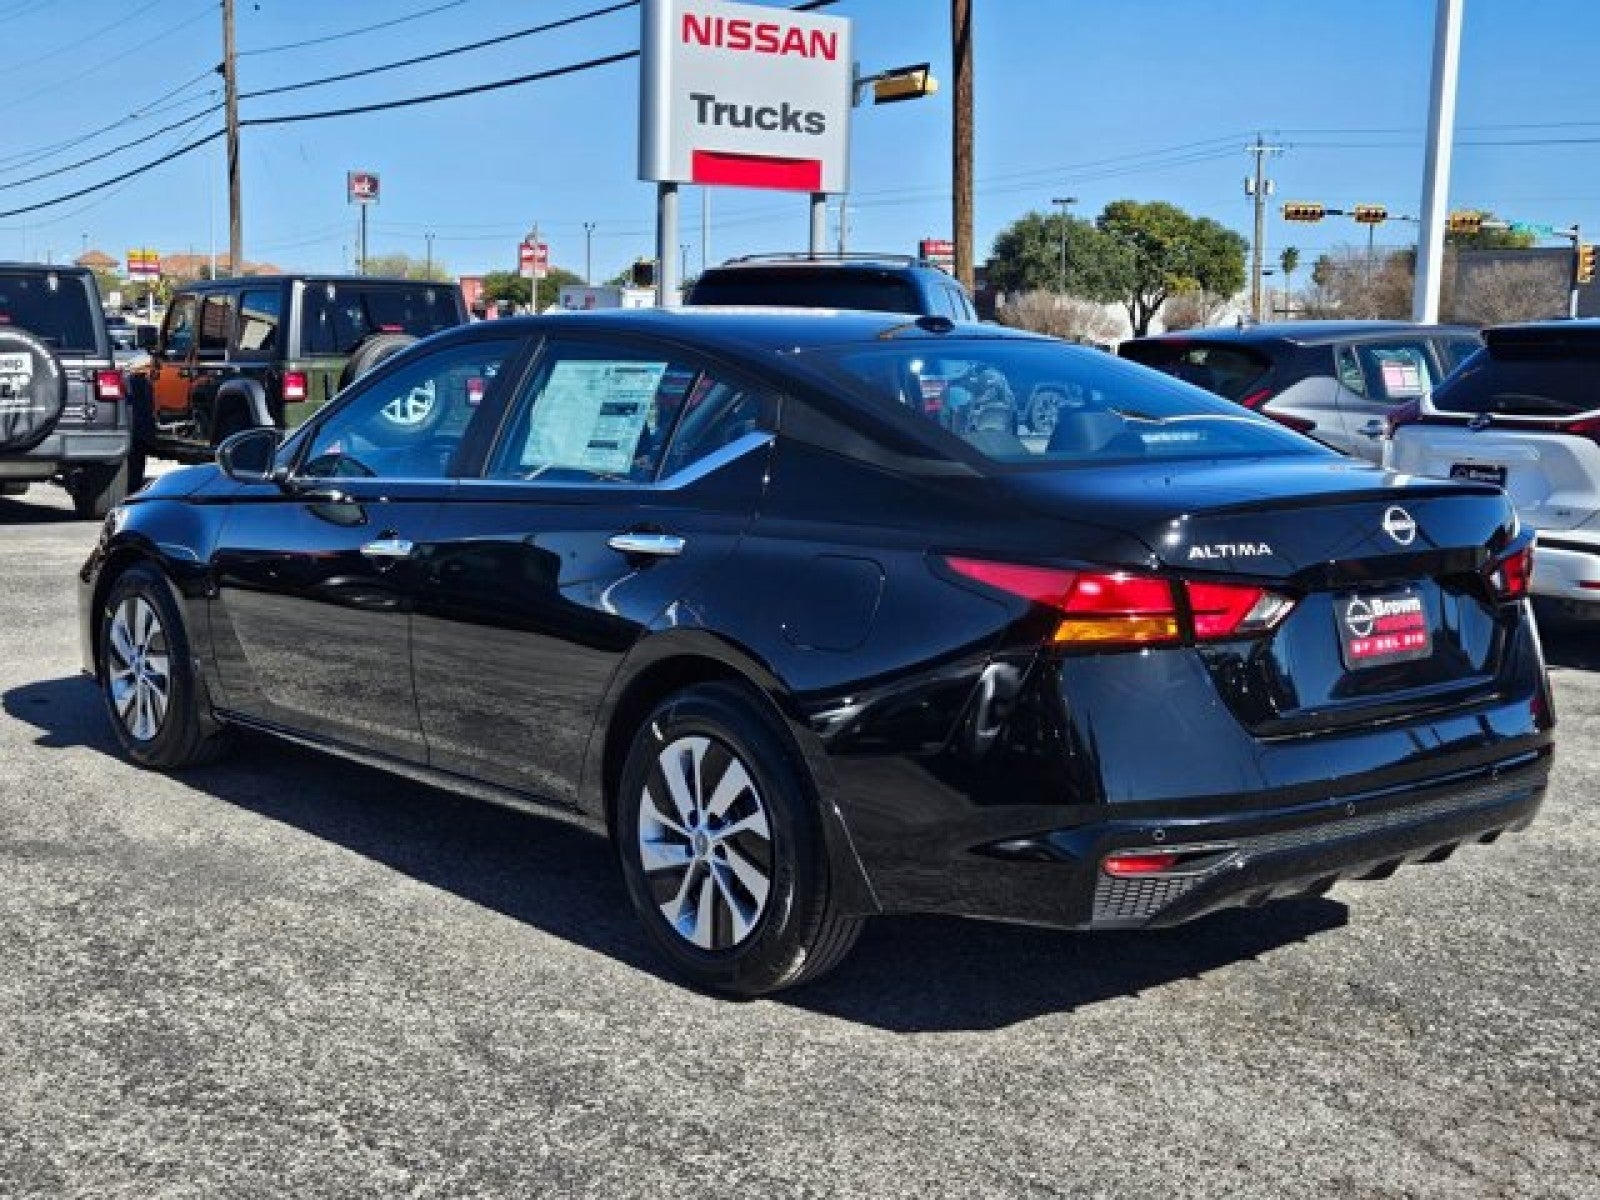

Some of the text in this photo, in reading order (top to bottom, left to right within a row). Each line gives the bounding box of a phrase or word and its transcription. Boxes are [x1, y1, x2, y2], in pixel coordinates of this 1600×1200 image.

[681, 12, 838, 61] NISSAN
[689, 91, 826, 135] Trucks
[1187, 542, 1274, 560] ALTIMA
